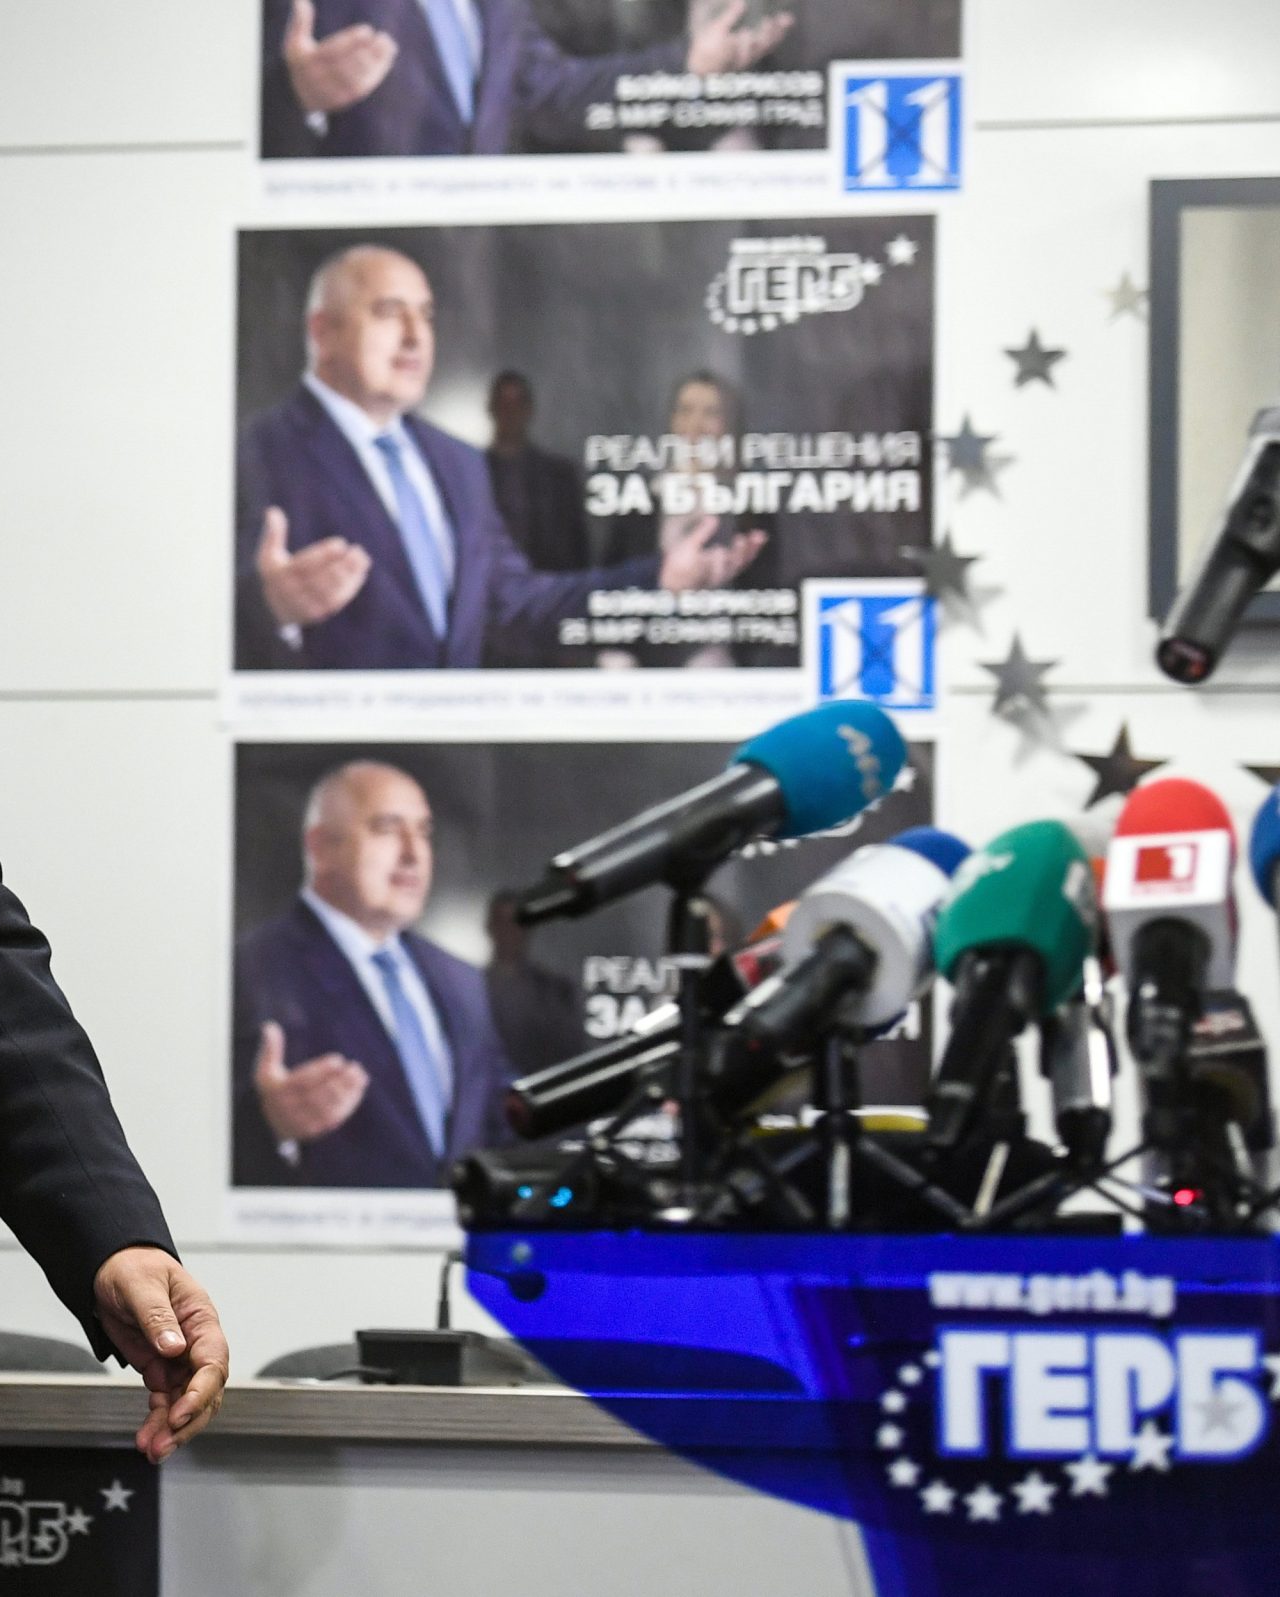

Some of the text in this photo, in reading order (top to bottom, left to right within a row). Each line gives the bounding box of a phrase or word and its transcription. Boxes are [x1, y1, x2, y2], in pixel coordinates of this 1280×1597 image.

[586, 431, 920, 471] РЕАЛНИ РЕШЕНИЯ
[585, 471, 920, 516] ЗА БЪЛГАРИЯ
[584, 956, 682, 994] РЕАЛ
[929, 1268, 1175, 1318] www.gerb.bg
[941, 1331, 1265, 1455] ГЕРБ
